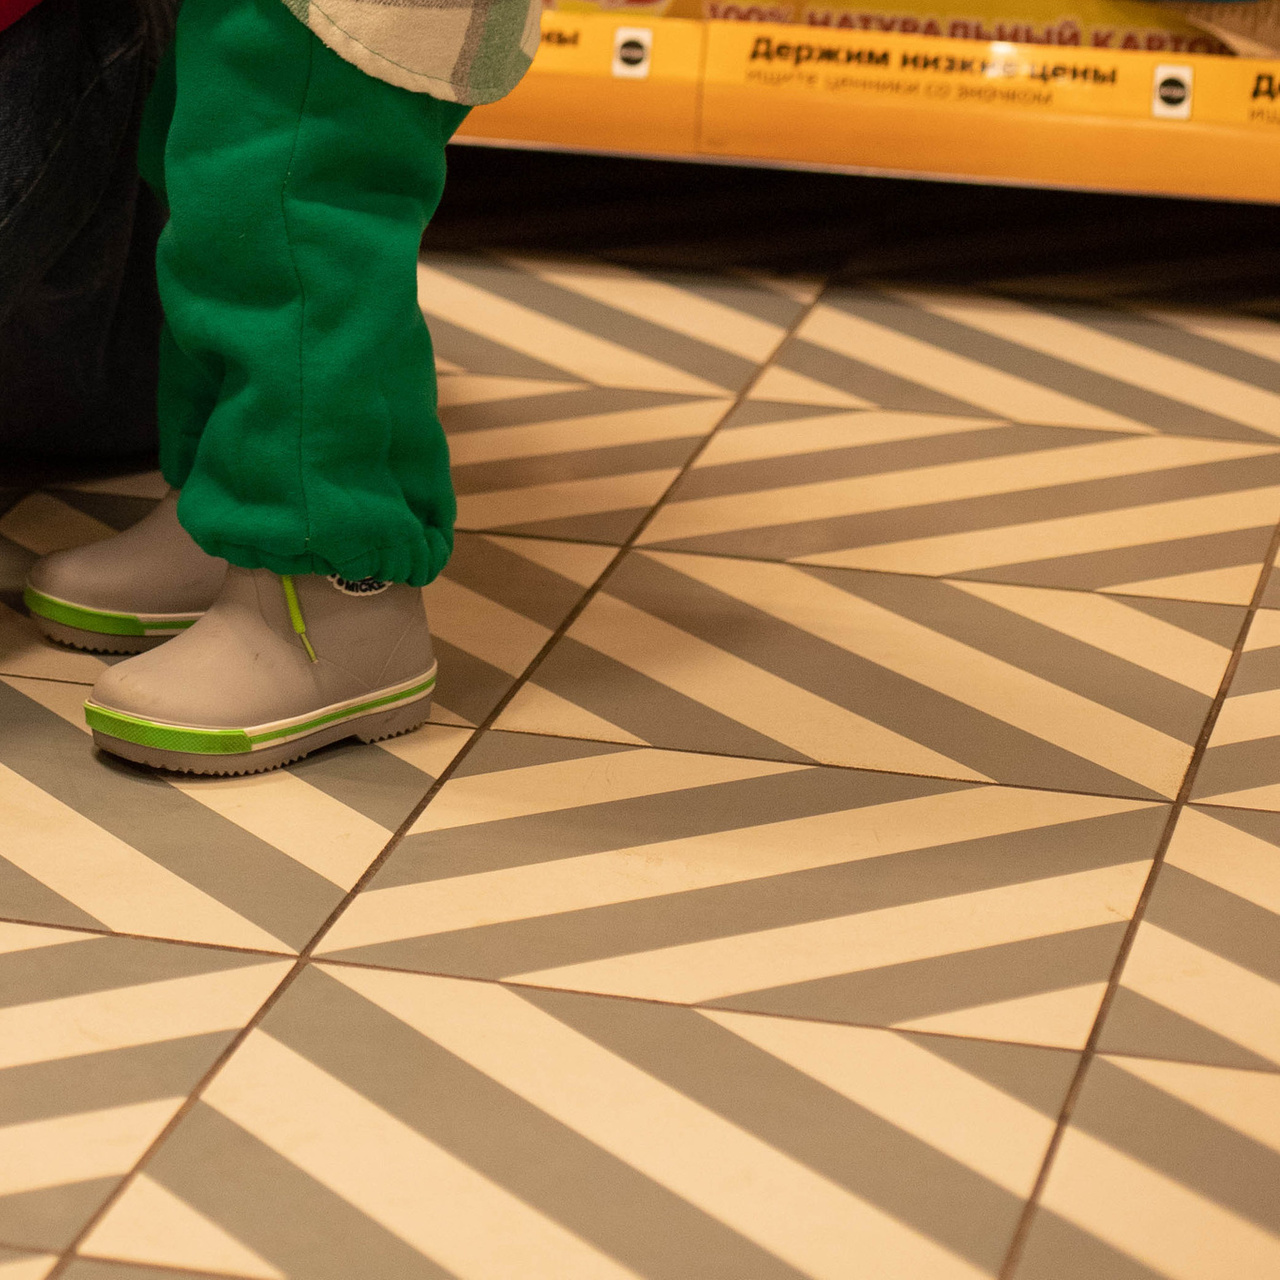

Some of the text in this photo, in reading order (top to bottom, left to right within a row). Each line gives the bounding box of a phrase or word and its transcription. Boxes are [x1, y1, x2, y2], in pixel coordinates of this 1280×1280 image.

[749, 36, 1117, 86] Держим низкие цены
